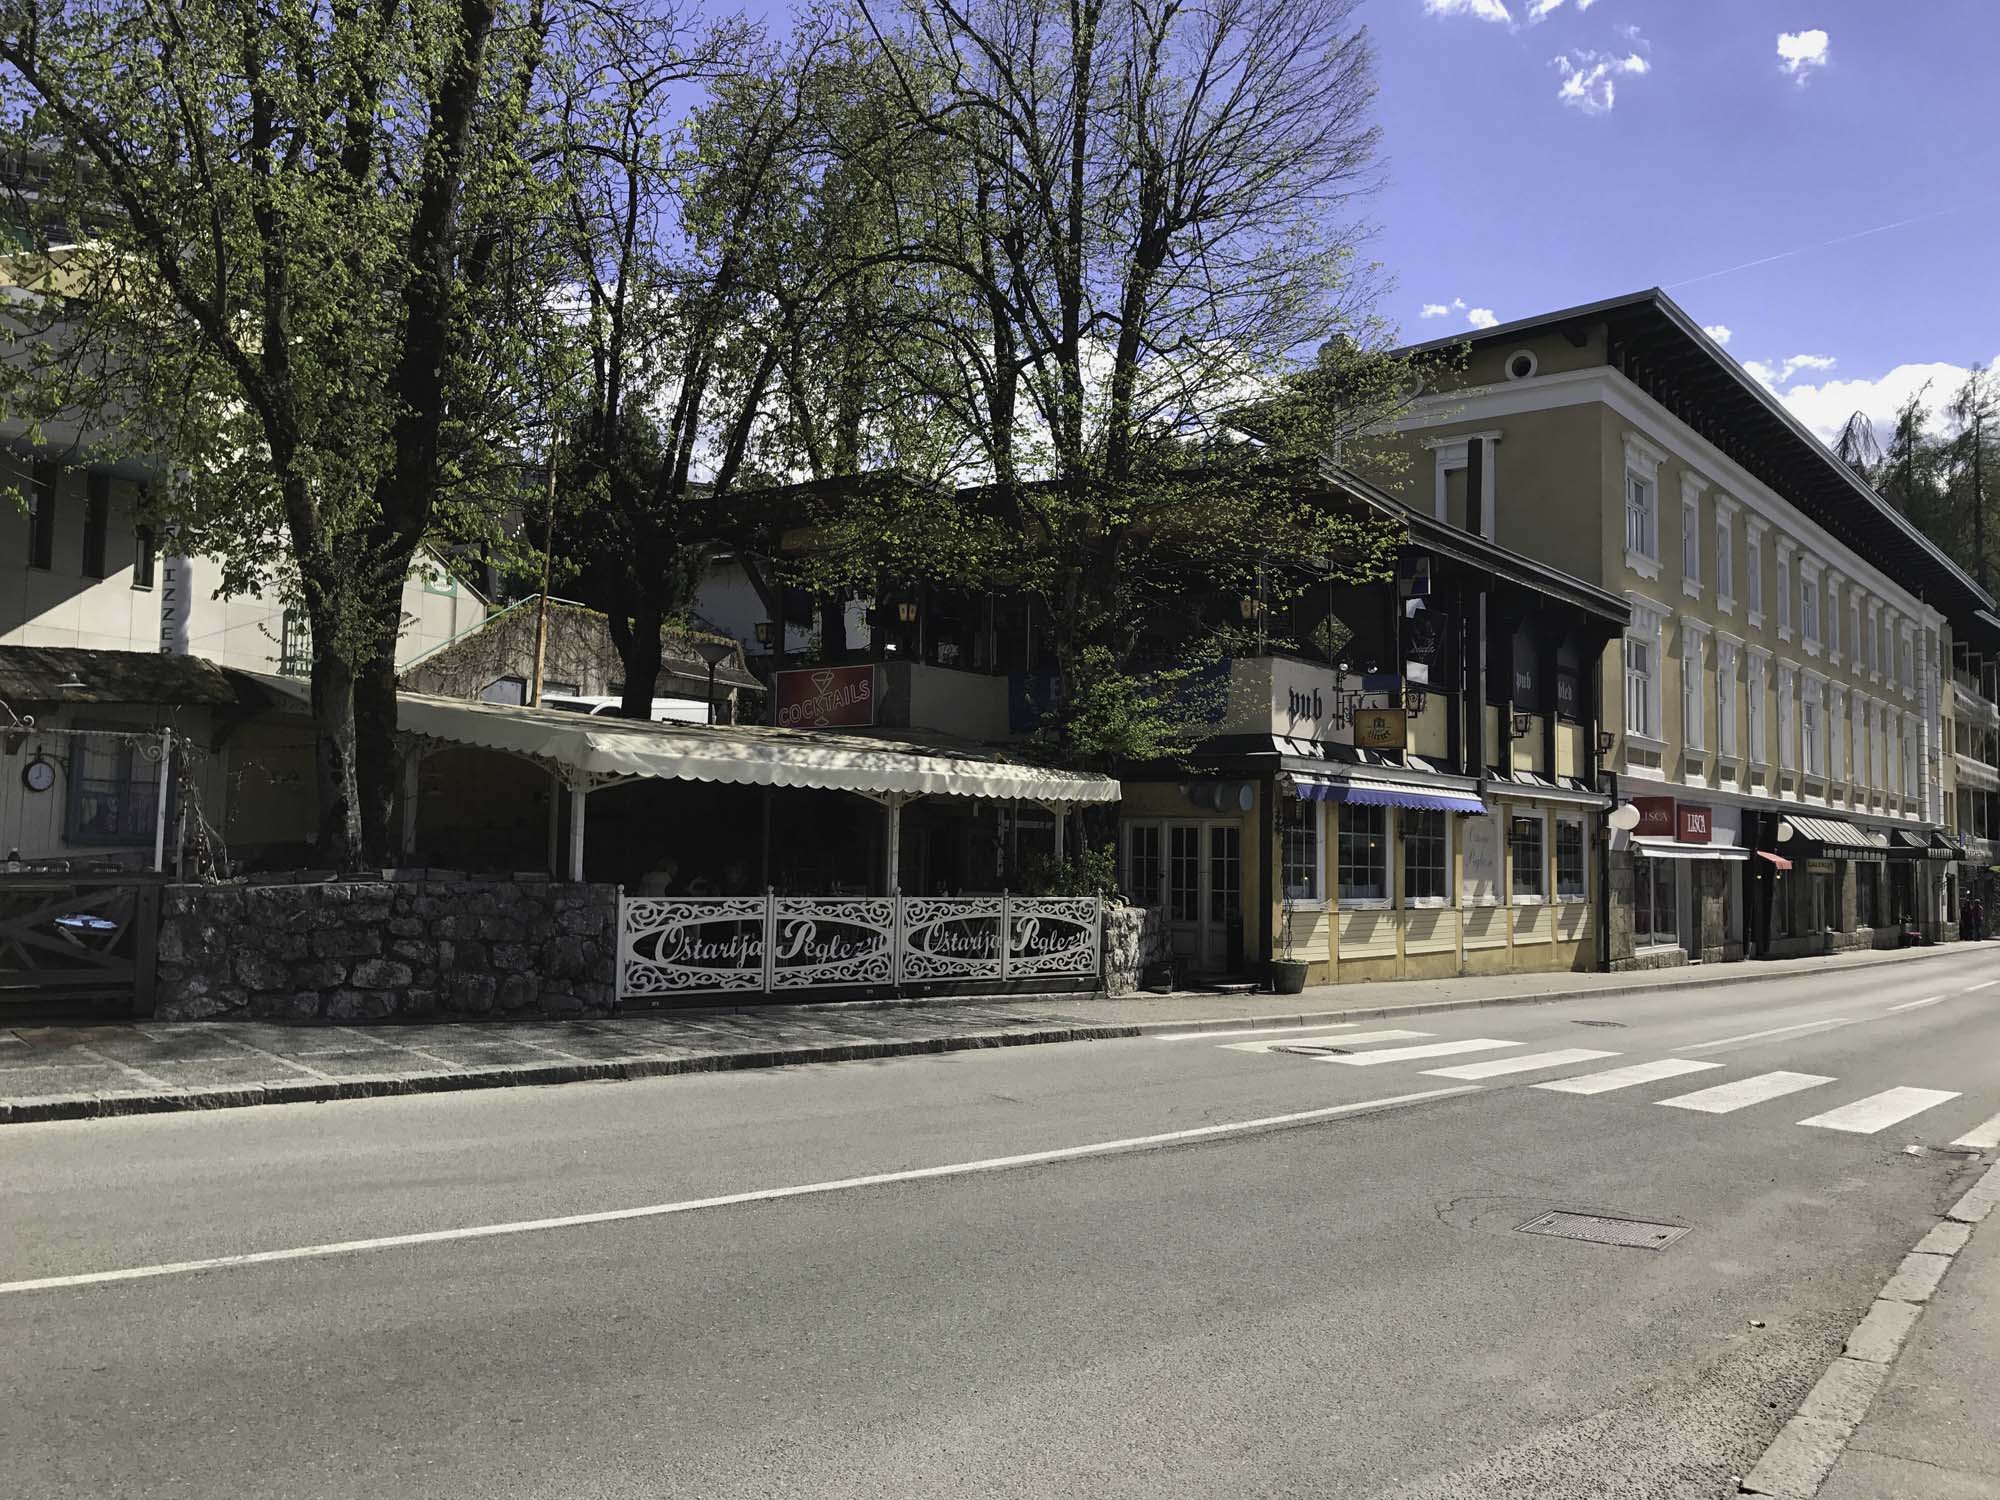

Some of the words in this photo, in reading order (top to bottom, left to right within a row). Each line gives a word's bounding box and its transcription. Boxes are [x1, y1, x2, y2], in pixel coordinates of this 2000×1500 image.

[779, 680, 870, 726] COCKTAILS
[1288, 686, 1322, 727] pub
[1687, 813, 1706, 833] LISCA
